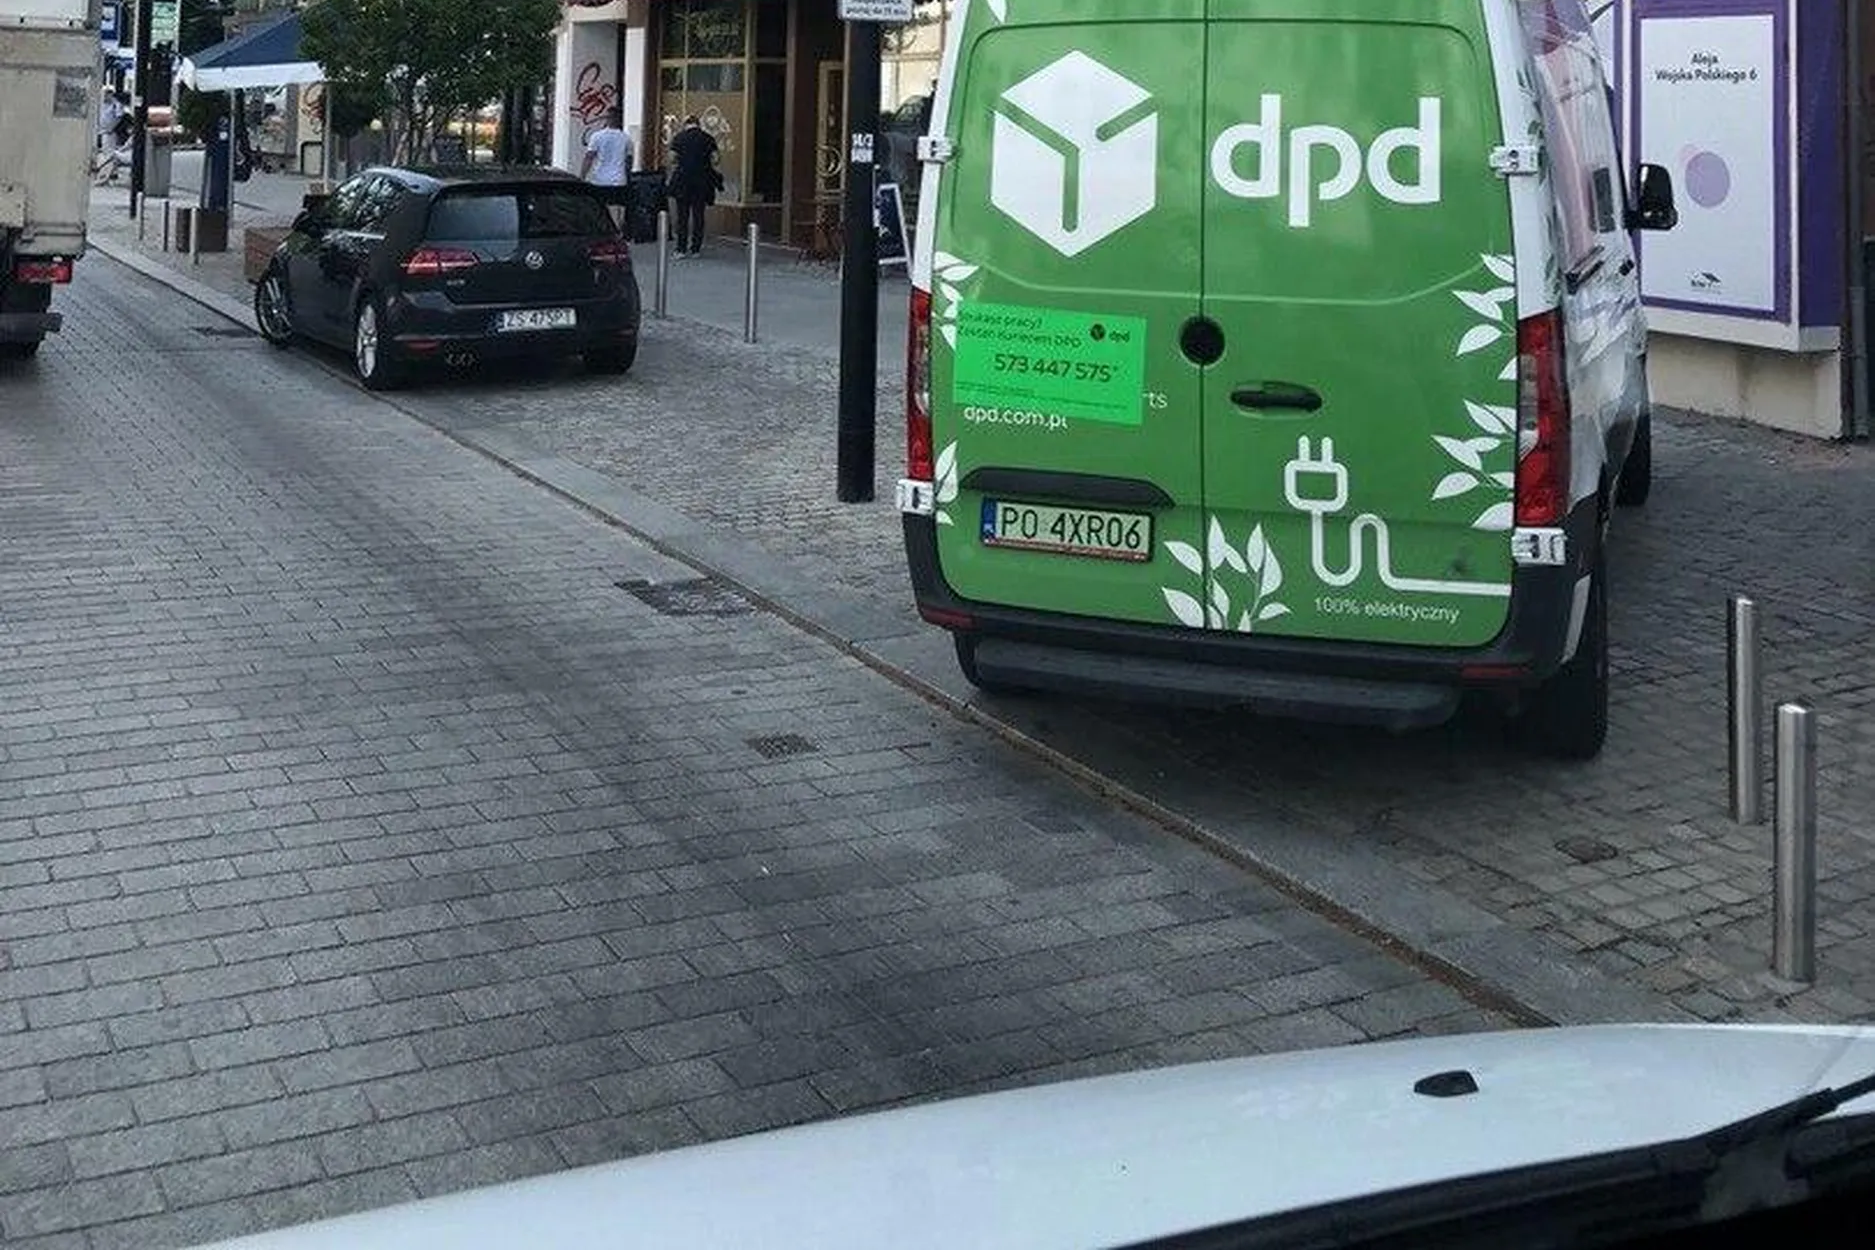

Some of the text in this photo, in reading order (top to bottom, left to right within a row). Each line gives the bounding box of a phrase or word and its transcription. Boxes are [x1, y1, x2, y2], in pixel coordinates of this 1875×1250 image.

[1691, 53, 1718, 67] Aleja
[1655, 68, 1693, 84] Wojska
[1695, 68, 1746, 84] Polskiego
[1210, 93, 1441, 228] dpd
[994, 353, 1029, 374] 573
[1032, 357, 1071, 379] 447
[1001, 506, 1141, 550] PO 4XR06
[1315, 597, 1460, 625] 100% elektryczny
